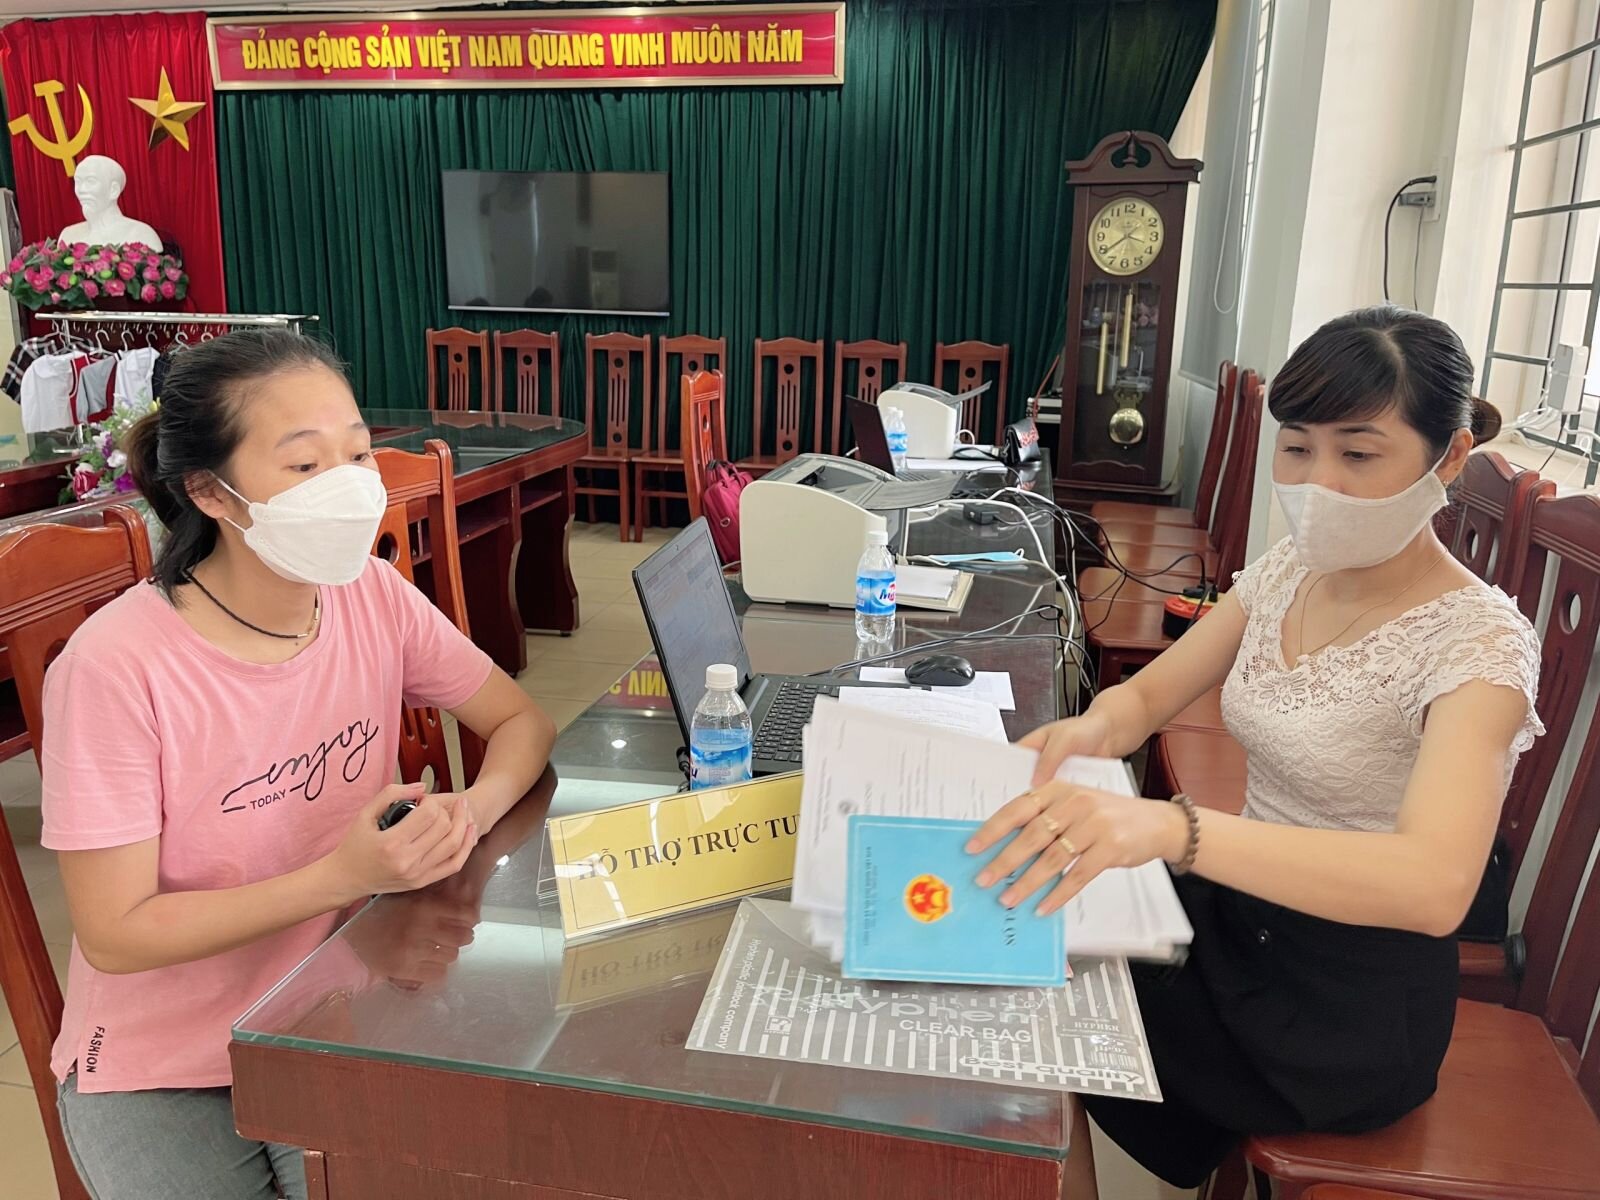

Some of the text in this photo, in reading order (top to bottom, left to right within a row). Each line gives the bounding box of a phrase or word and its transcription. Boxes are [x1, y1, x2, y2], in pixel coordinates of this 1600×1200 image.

[241, 22, 803, 74] ĐẢNG CỘNG SẢN VIỆT NAM QUANG VINH MUÔN NĂM
[1111, 208, 1120, 217] 11
[1125, 203, 1136, 213] 12
[1141, 207, 1145, 217] 1
[1101, 218, 1111, 228] 10
[1148, 217, 1157, 227] 2
[1097, 232, 1105, 241] 9
[1149, 231, 1159, 242] 3
[1099, 245, 1108, 254] 8
[1144, 245, 1152, 255] 4
[1107, 256, 1117, 265] 7
[1120, 258, 1129, 268] 6
[1134, 256, 1143, 266] 5
[221, 718, 379, 801] enjoy
[250, 789, 286, 809] TODAY
[625, 838, 682, 872] TRỢ
[688, 822, 760, 856] TRỰC
[765, 814, 800, 839] TU
[715, 1009, 735, 1049] company
[900, 1020, 1032, 1043] CLEAR BAG
[86, 1026, 105, 1073] FASHION
[965, 1057, 1139, 1082] Best quality
